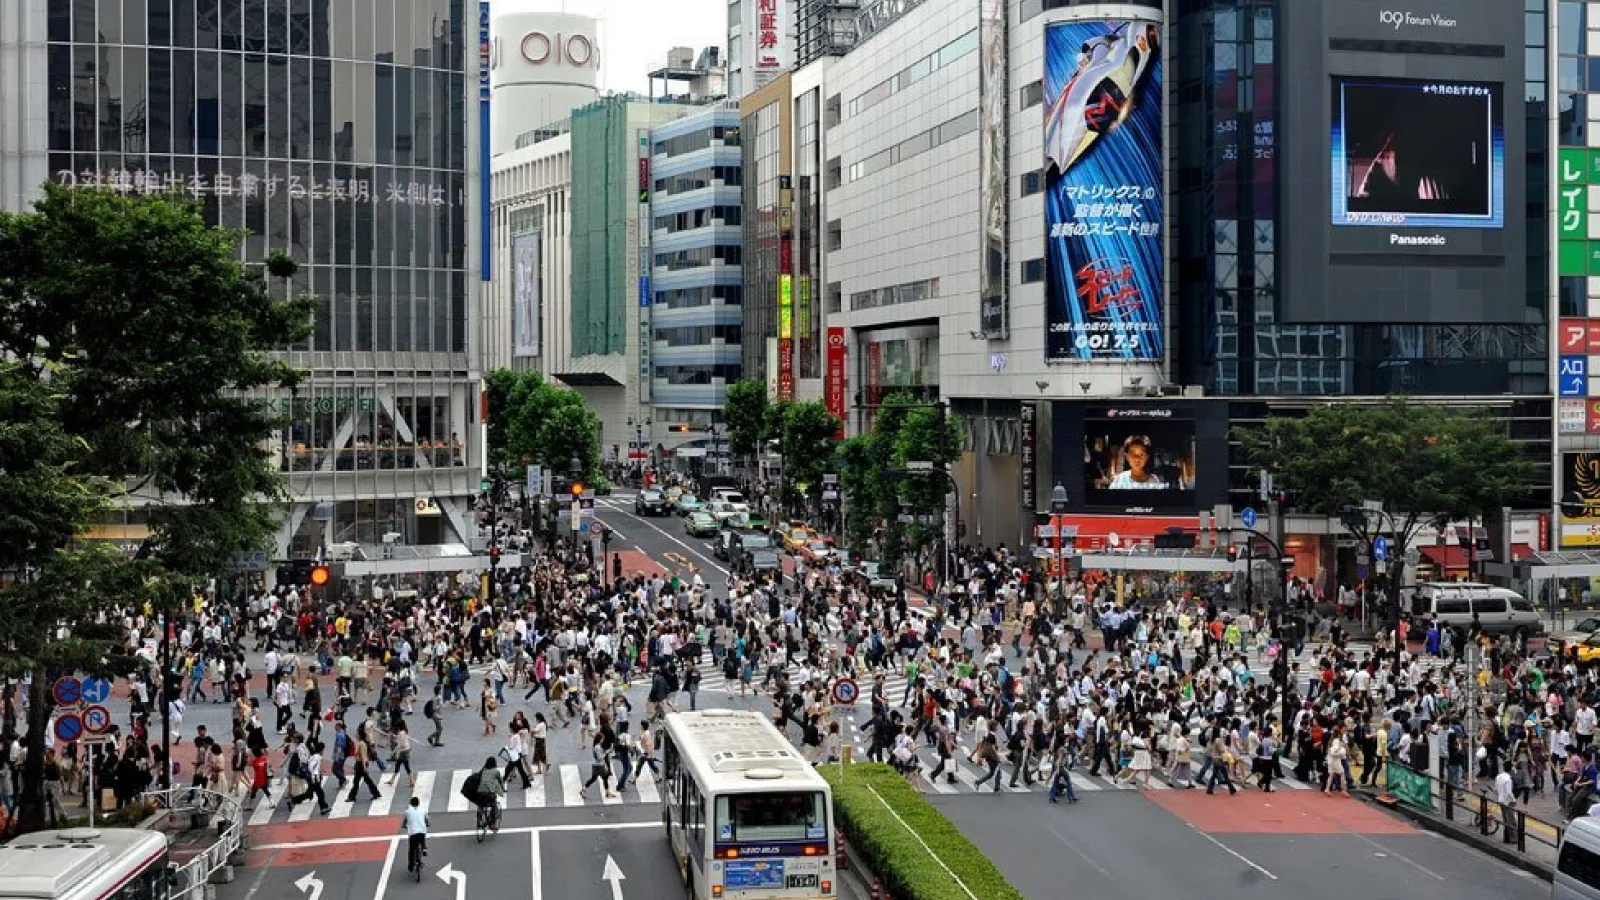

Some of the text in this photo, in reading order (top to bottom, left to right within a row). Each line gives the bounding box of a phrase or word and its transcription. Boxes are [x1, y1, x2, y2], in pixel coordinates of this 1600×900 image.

[1380, 10, 1457, 30] 109 Forum Vision
[1060, 186, 1155, 200] 「マトリックス」の
[1562, 159, 1582, 231] レイク
[1074, 203, 1143, 218] 監督が描く
[1390, 234, 1446, 246] Panasonic
[1075, 334, 1139, 349] GO! 7.5
[1561, 359, 1583, 375] 入口
